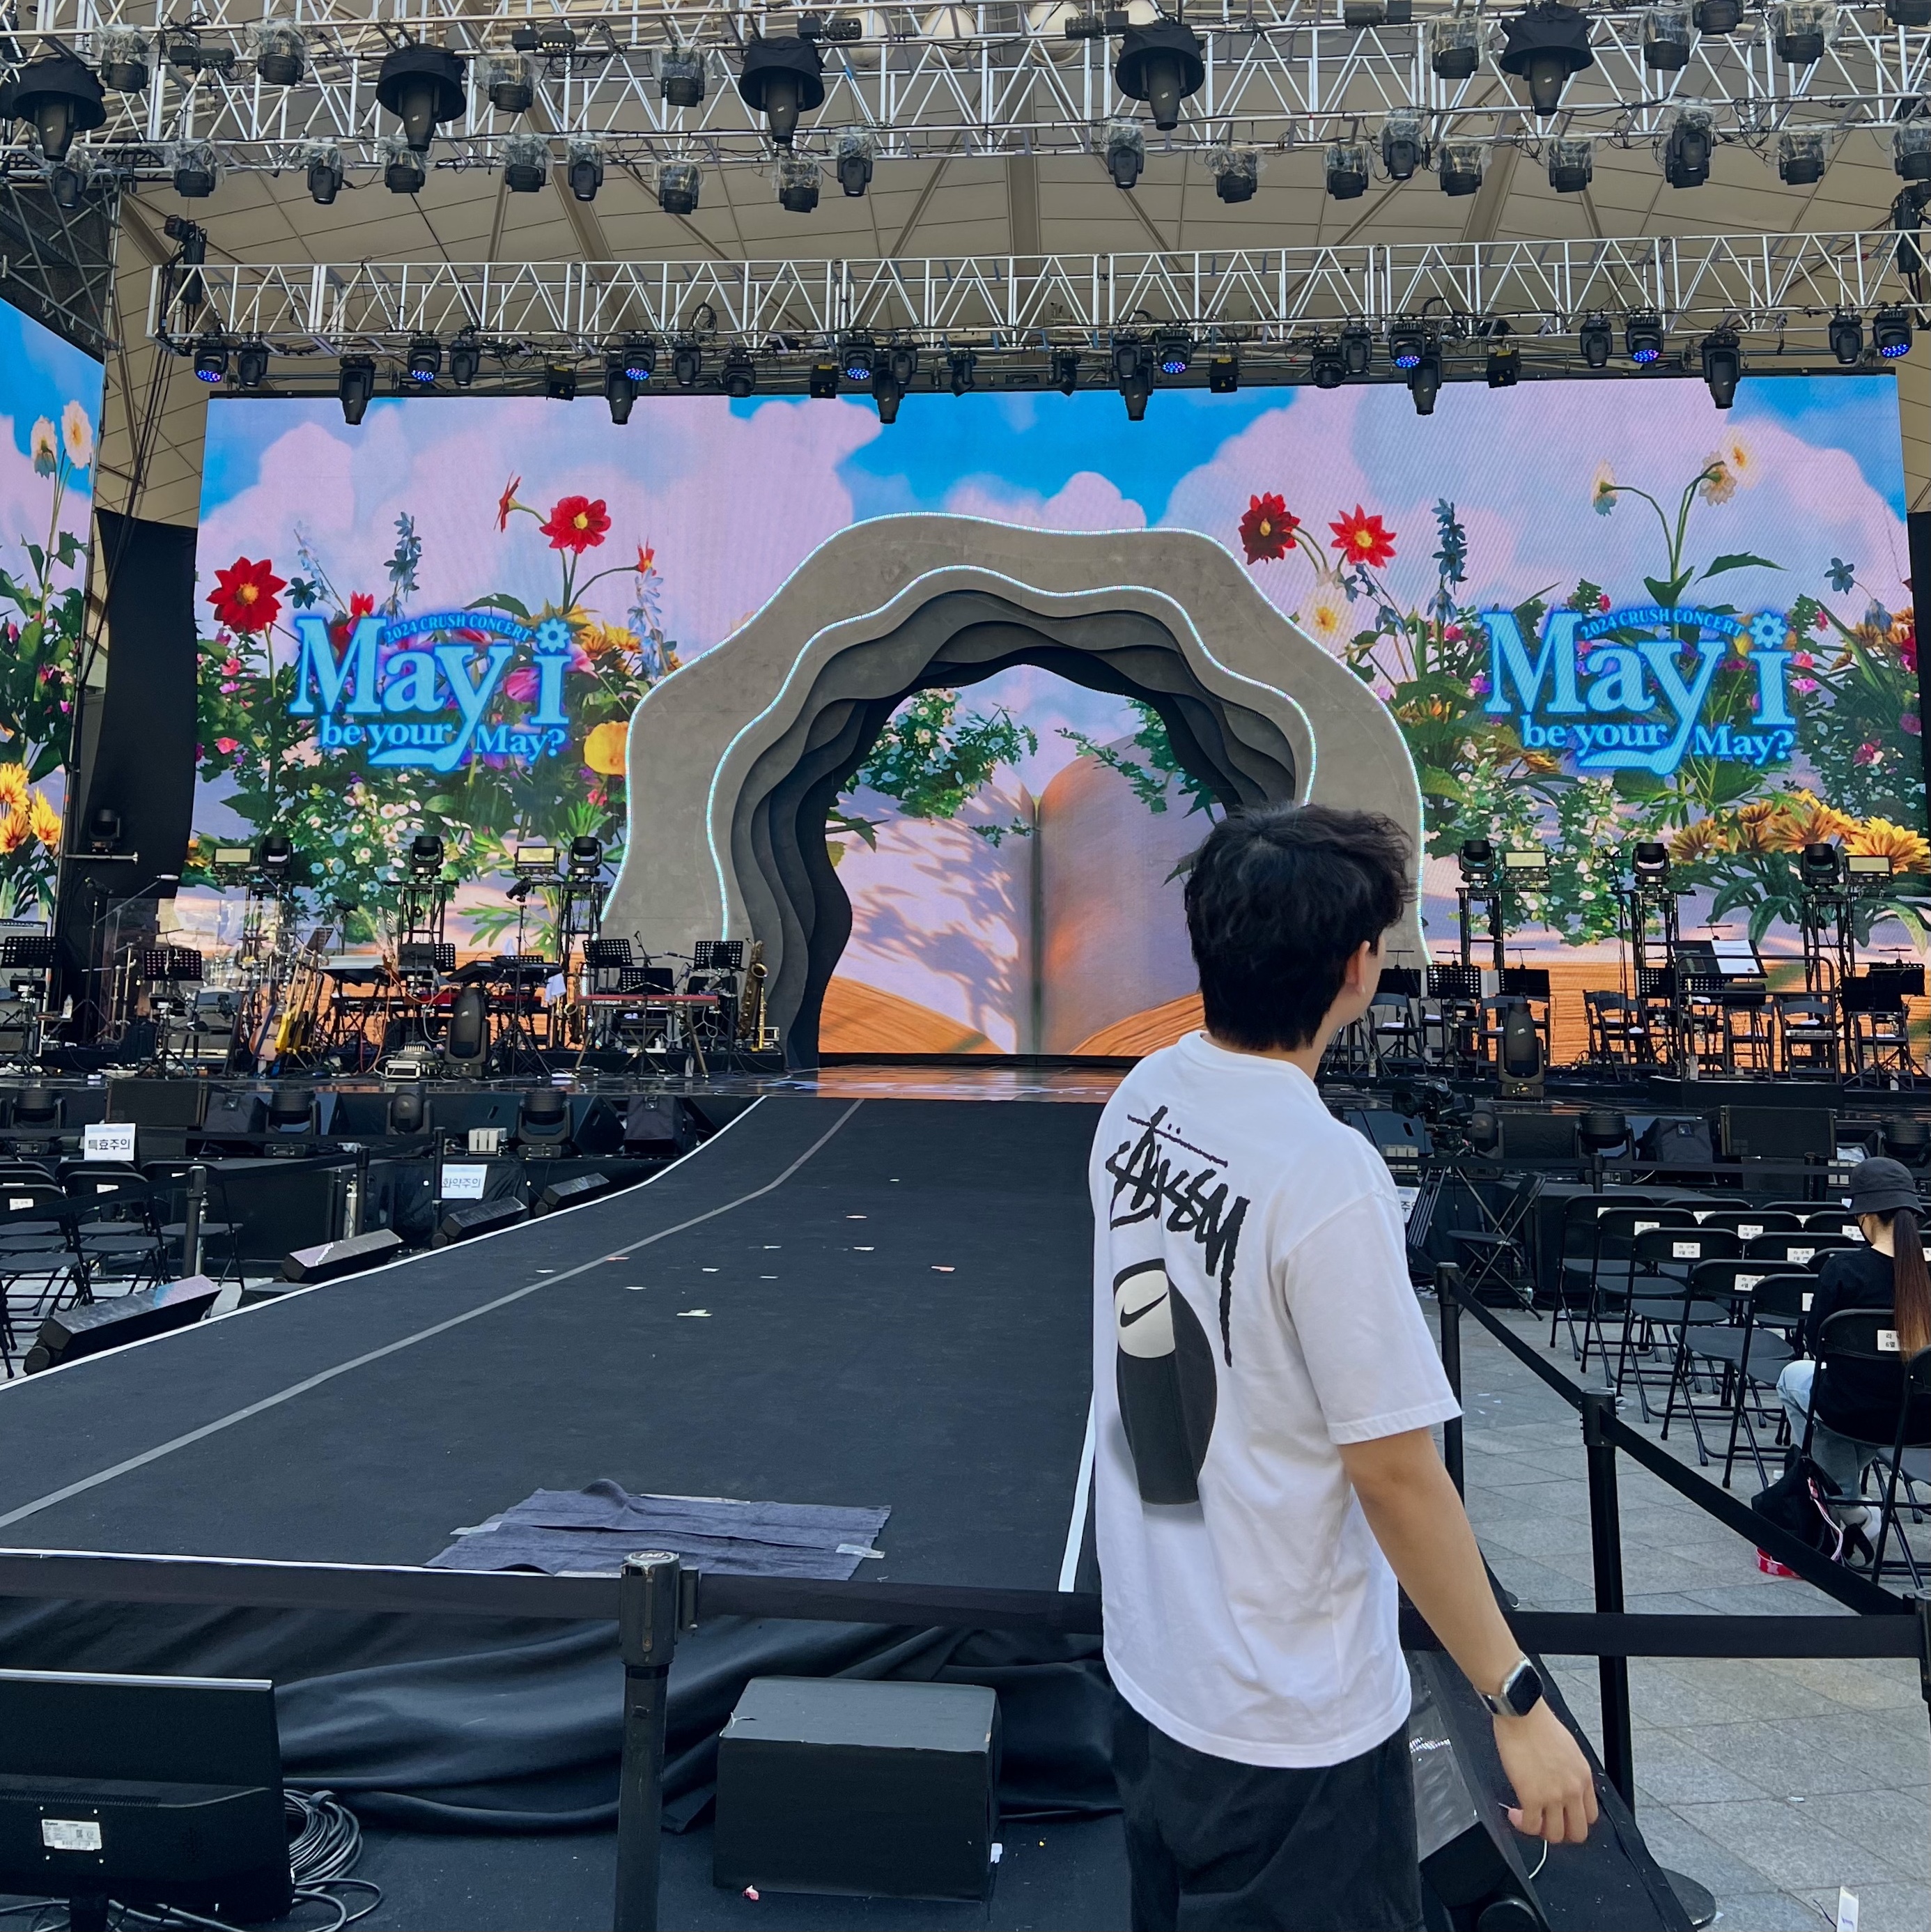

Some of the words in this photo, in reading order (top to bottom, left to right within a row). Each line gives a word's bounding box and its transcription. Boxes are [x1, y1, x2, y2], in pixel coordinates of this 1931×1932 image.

[385, 621, 417, 643] 2024
[420, 614, 466, 631] CRUSH
[469, 615, 532, 641] CONCERT
[1581, 616, 1617, 640] 2024
[1619, 608, 1670, 626] CRUSH
[1673, 609, 1744, 637] CONCERT
[289, 618, 513, 772] May
[1482, 612, 1726, 775] May
[321, 715, 361, 745] be
[368, 722, 453, 755] your
[475, 725, 566, 762] May?
[1521, 715, 1567, 748] be
[1573, 724, 1668, 757] your
[1693, 725, 1794, 766] May?
[442, 1178, 481, 1189] 화약주의
